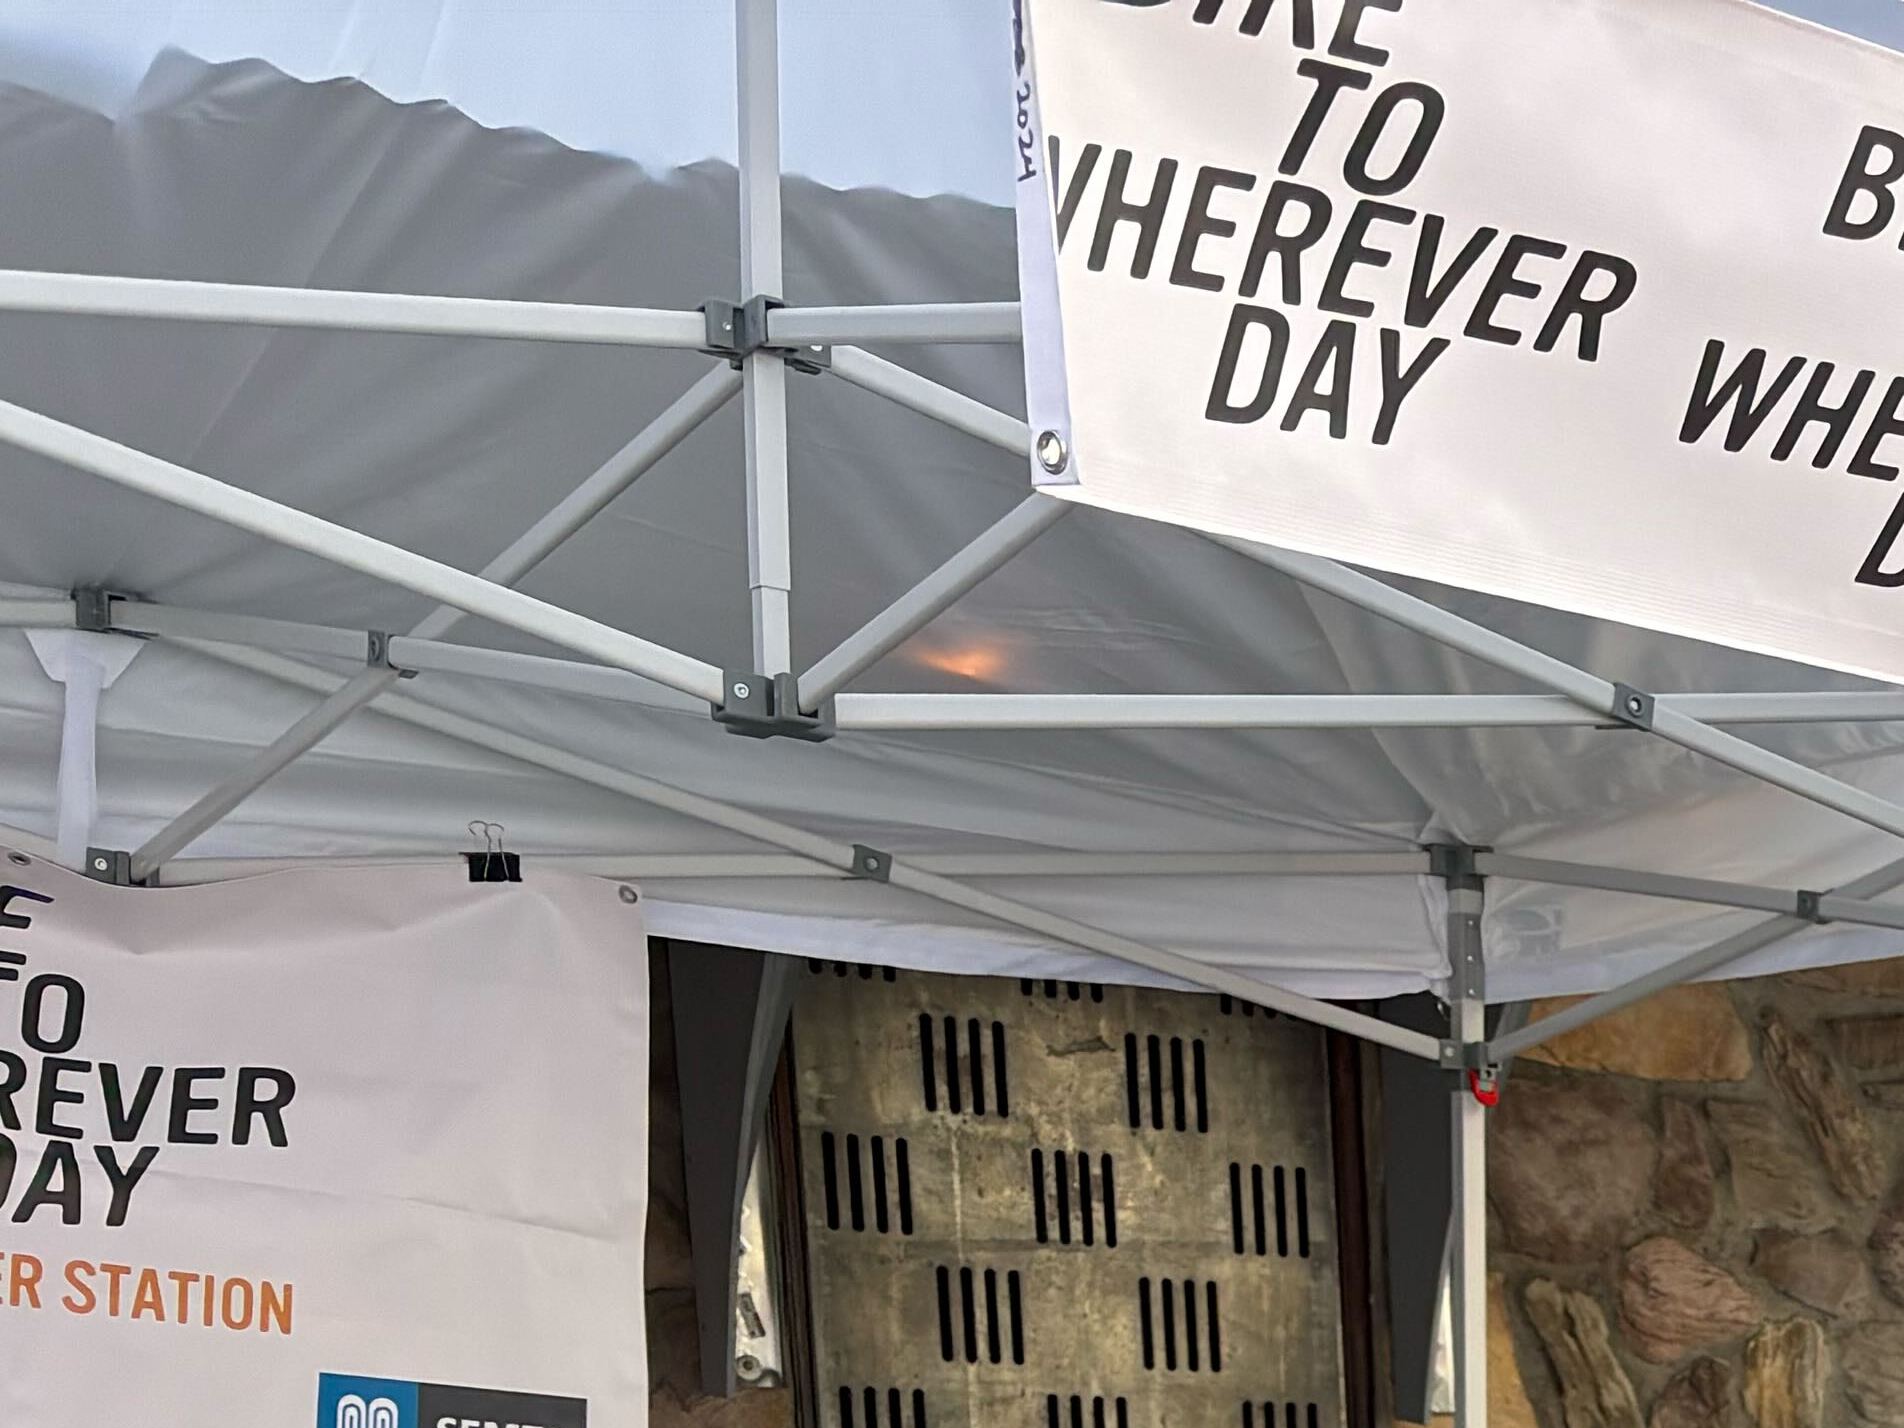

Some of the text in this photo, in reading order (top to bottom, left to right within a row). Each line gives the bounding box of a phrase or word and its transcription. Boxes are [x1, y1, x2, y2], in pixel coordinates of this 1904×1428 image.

[1279, 59, 1444, 195] TO
[1206, 304, 1450, 445] DAY
[0, 1133, 159, 1226] AY
[0, 1250, 292, 1335] R STATION
